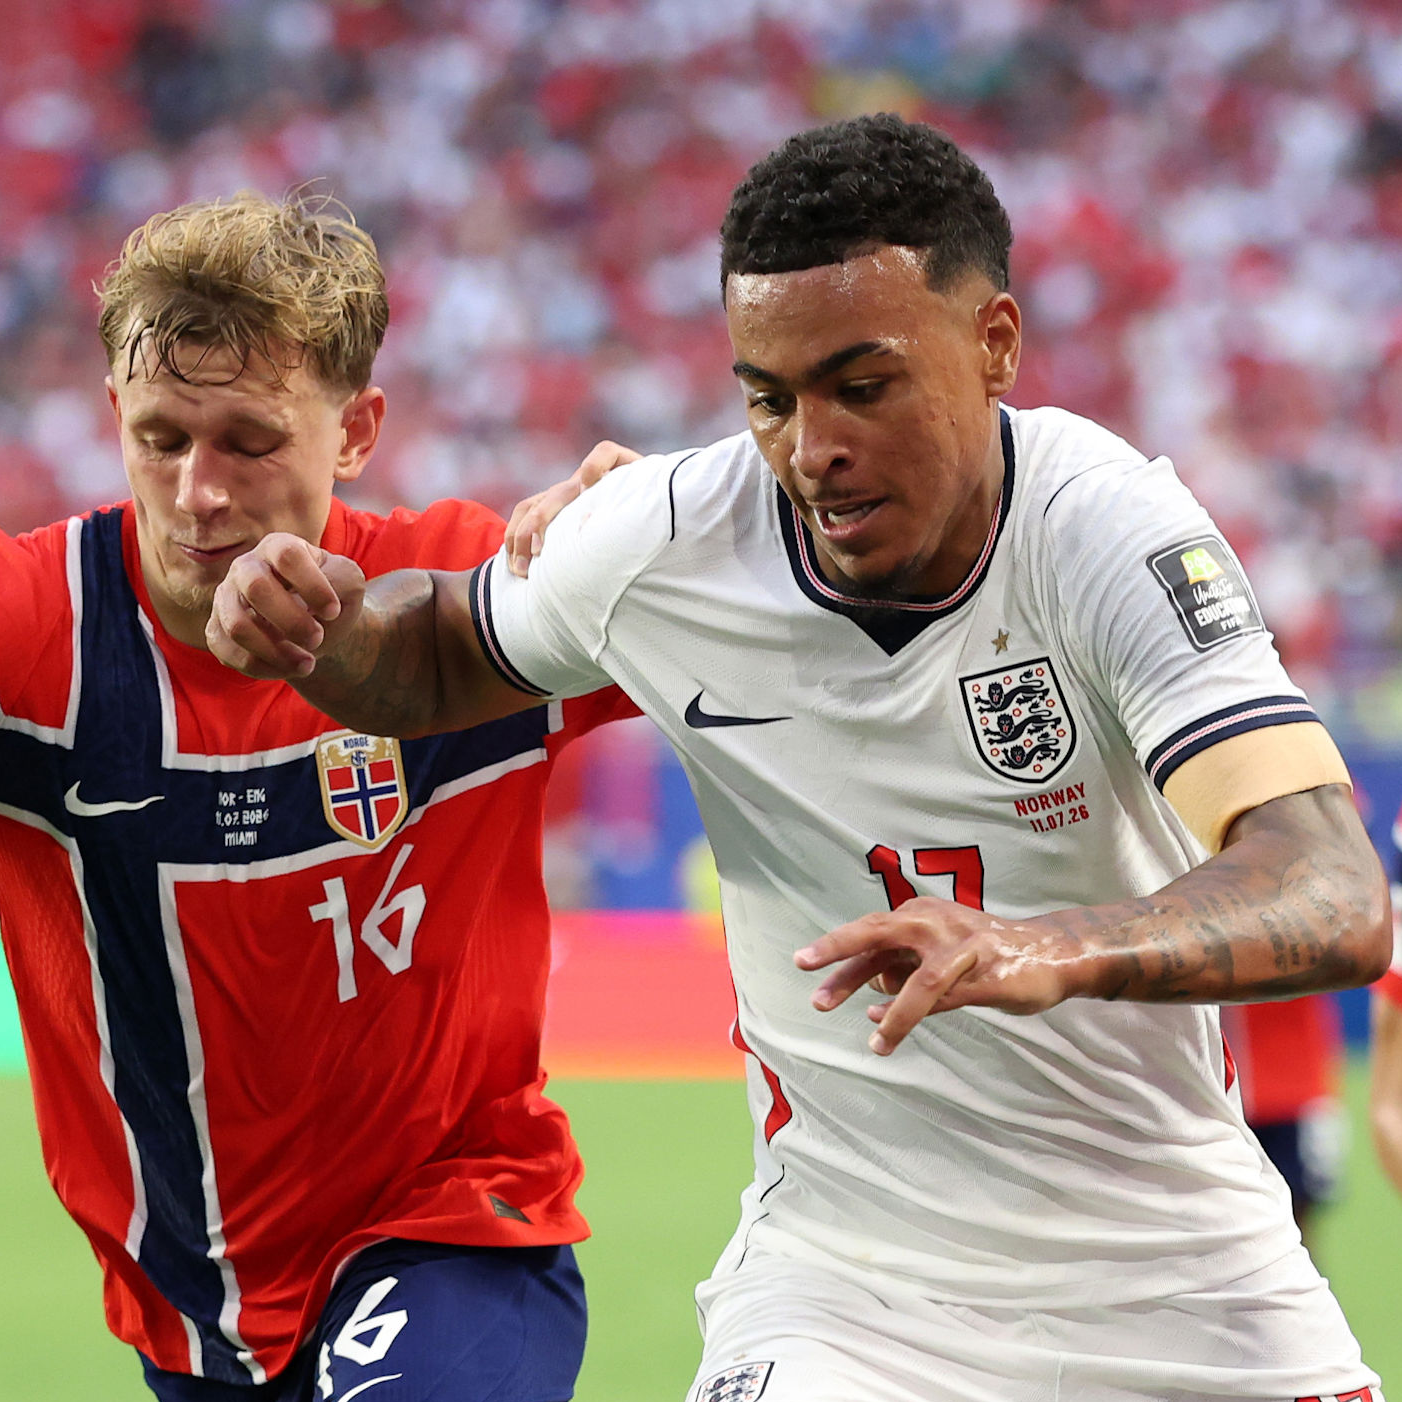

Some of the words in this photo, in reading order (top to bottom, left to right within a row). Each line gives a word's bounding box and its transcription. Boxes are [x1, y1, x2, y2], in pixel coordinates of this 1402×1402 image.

[343, 736, 369, 750] NORGE
[246, 787, 266, 804] ENG
[1014, 781, 1086, 817] NORWAY
[1030, 804, 1090, 833] 11.07.26
[224, 831, 258, 847] MIAMI
[865, 844, 985, 912] 17
[308, 843, 427, 1003] 16
